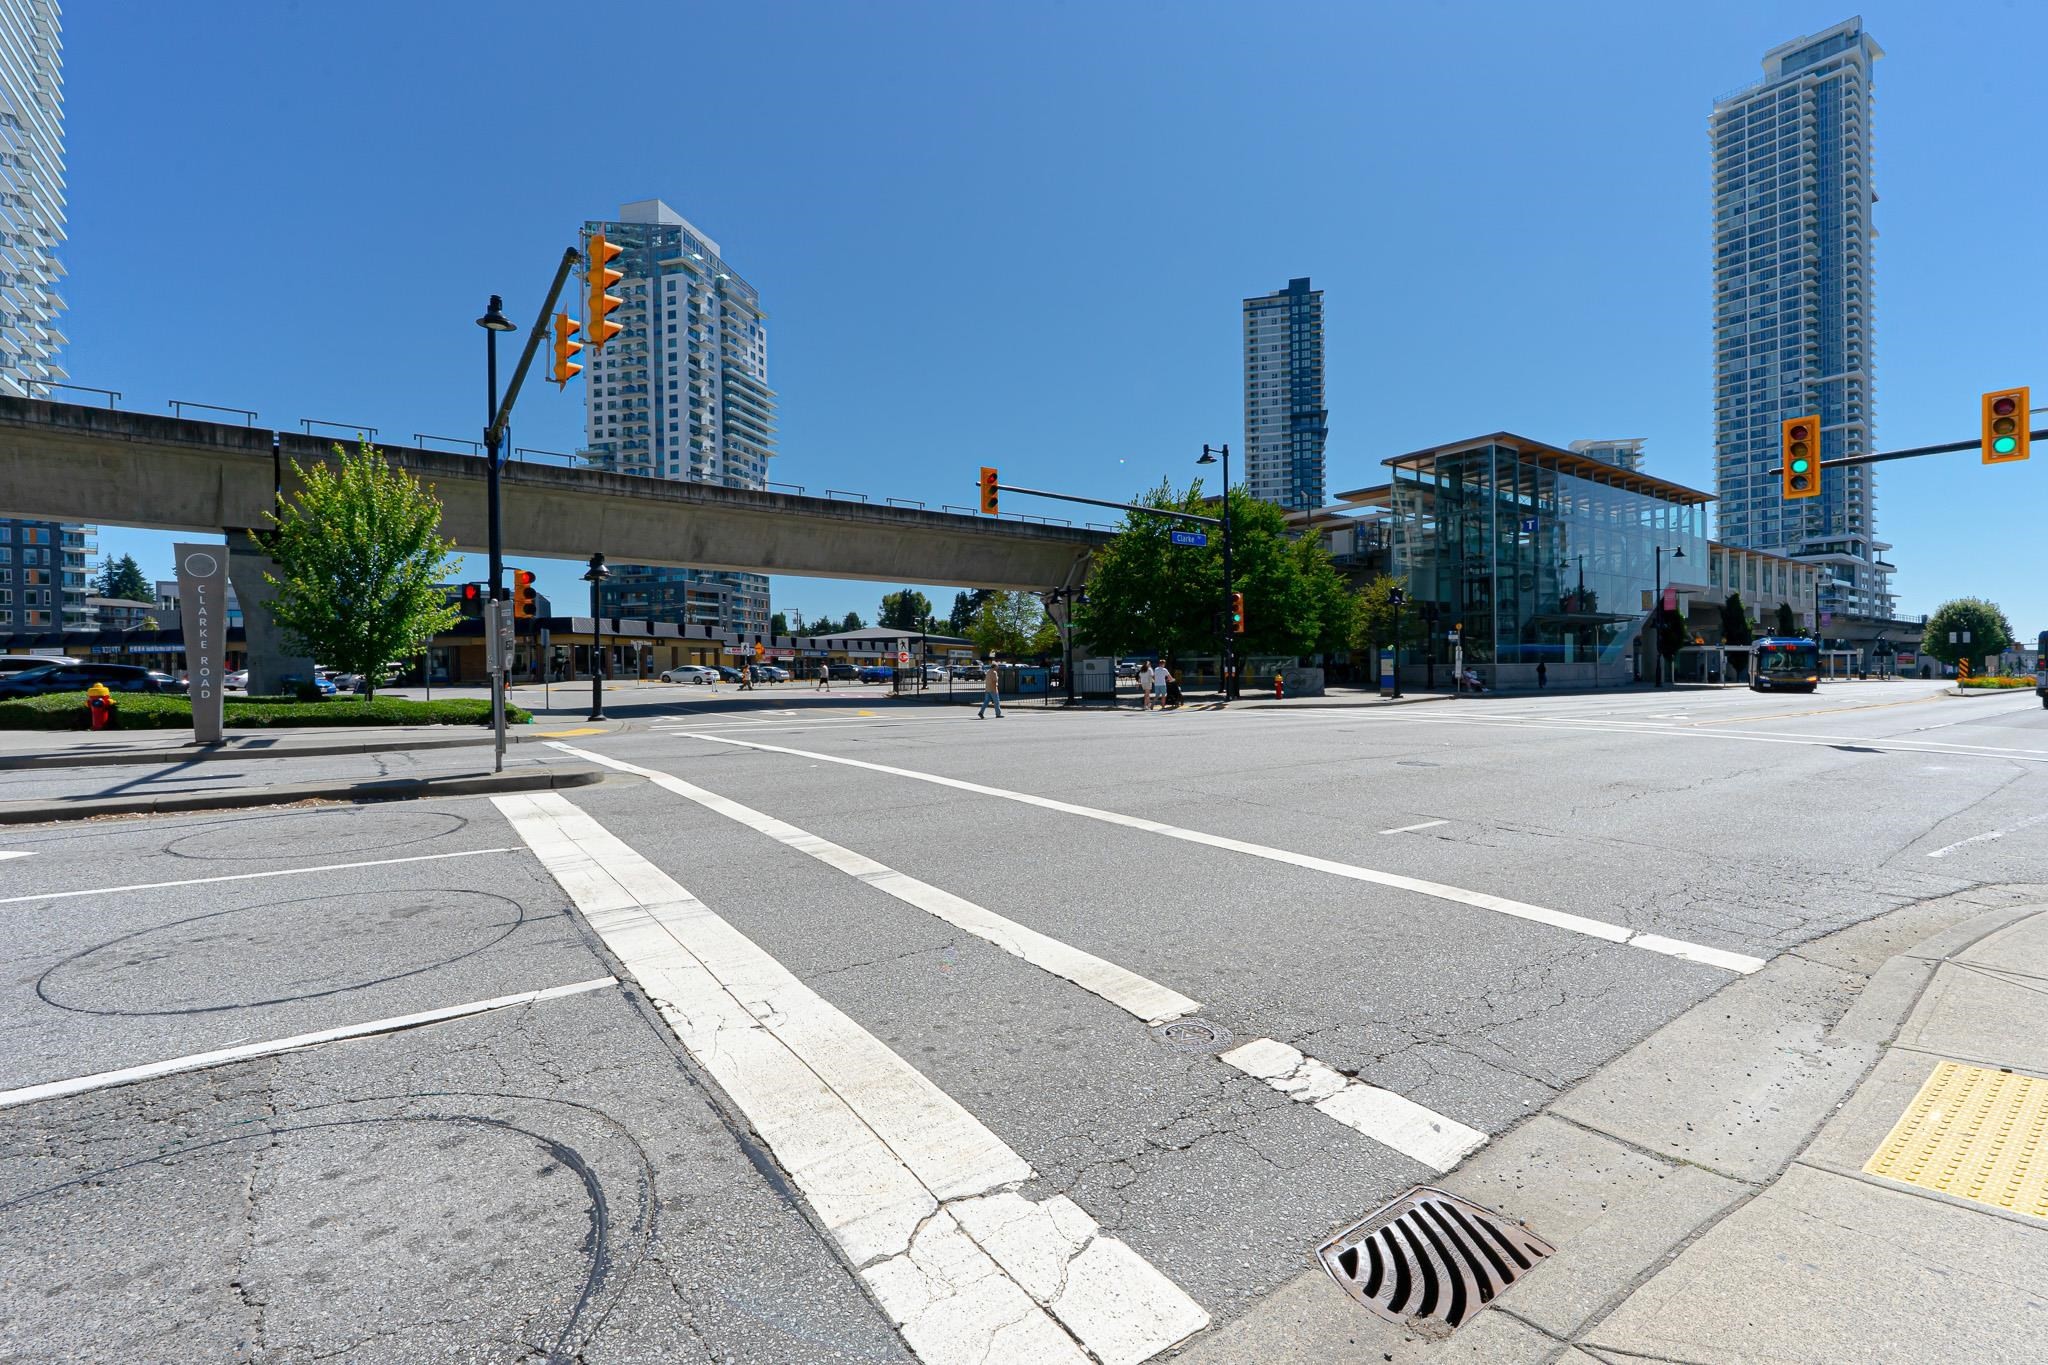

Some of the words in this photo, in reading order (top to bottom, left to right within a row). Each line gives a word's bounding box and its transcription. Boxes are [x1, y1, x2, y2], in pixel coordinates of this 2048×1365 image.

[1526, 520, 1535, 530] T
[198, 584, 208, 649] CLARKE
[200, 656, 211, 699] ROAD
